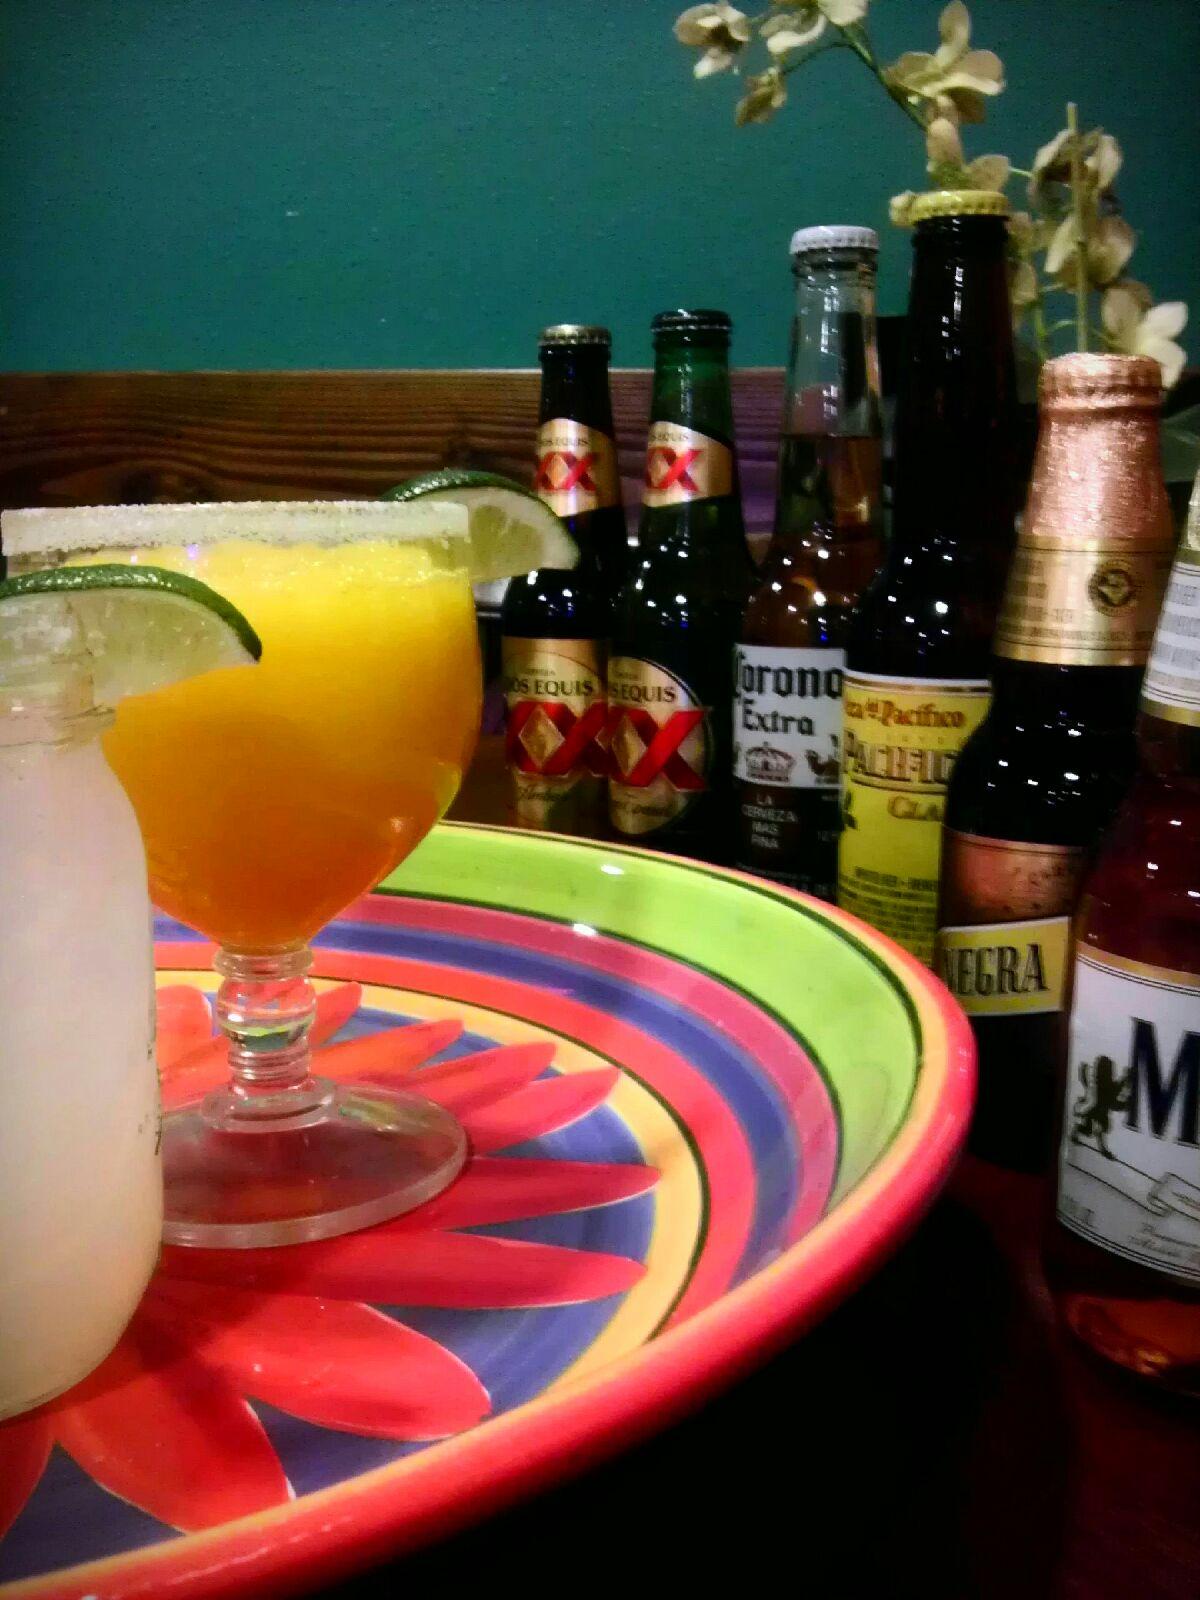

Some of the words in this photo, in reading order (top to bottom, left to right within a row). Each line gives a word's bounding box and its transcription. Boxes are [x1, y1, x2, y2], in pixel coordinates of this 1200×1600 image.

[535, 679, 593, 697] EQUIS
[621, 684, 676, 702] EQUIS
[742, 698, 814, 735] Extra
[757, 794, 773, 806] LA
[742, 803, 798, 823] CERVEZA
[946, 944, 1050, 996] NEGRA
